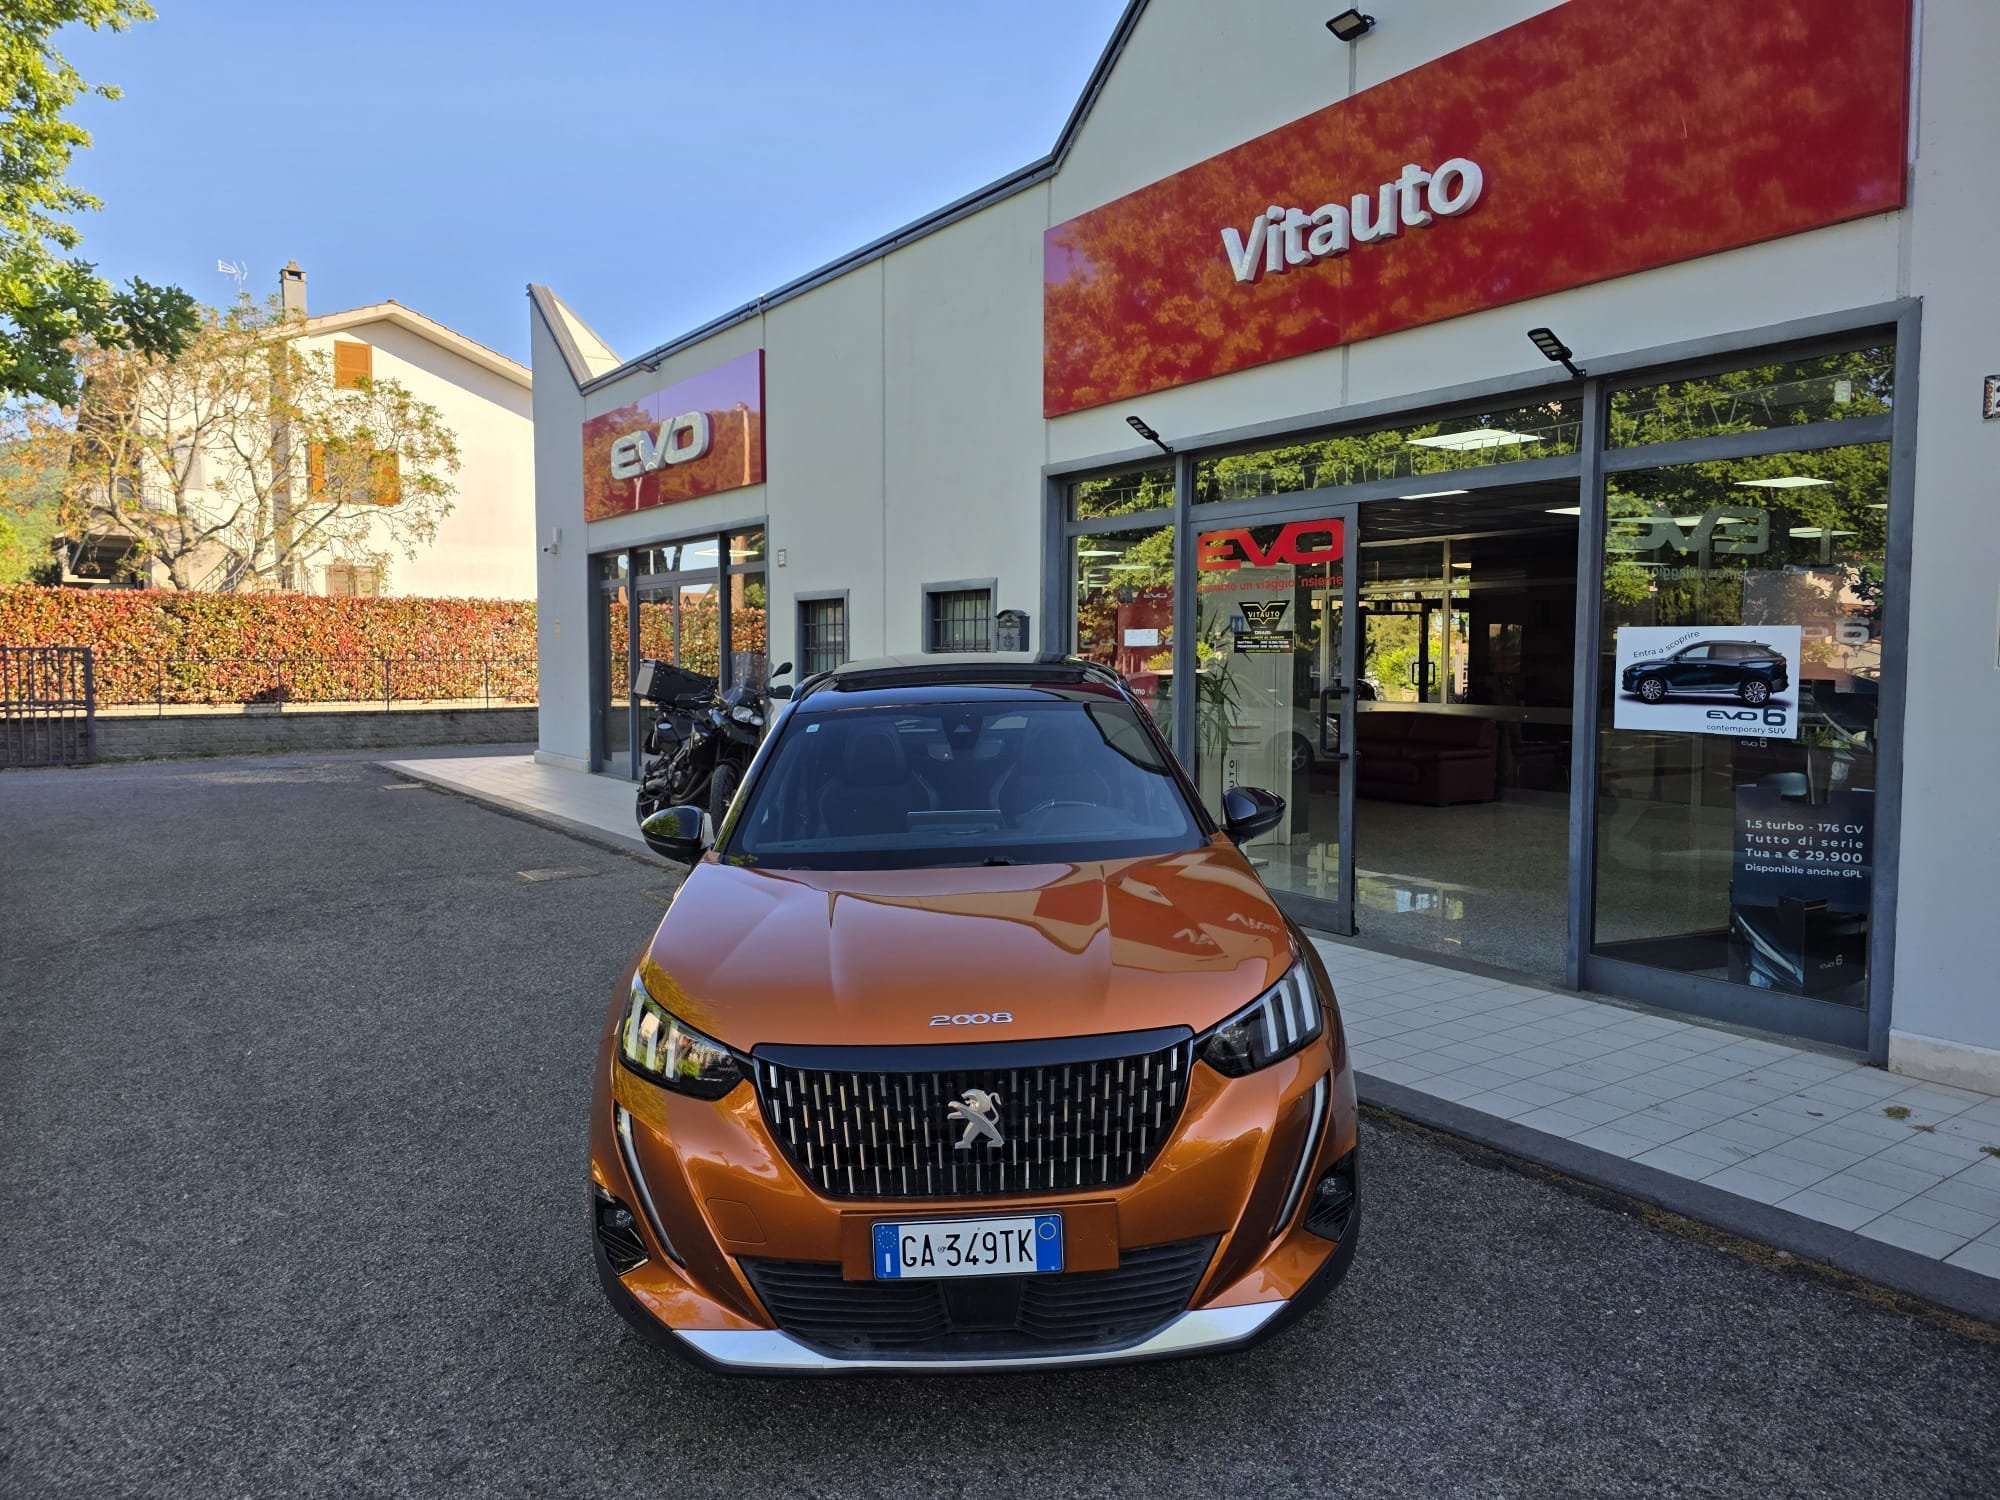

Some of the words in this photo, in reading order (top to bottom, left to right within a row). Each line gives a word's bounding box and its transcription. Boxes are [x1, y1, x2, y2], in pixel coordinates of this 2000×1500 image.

[1220, 157, 1484, 283] Vitauto
[610, 411, 710, 480] EVO
[1197, 518, 1344, 571] EVO
[1633, 648, 1657, 658] Entra
[1665, 631, 1701, 652] scoprire
[1706, 710, 1758, 721] EVO
[1763, 705, 1787, 727] 6
[1706, 724, 1766, 735] contemporary
[1768, 727, 1787, 735] SUV
[1745, 819, 1762, 829] 1.5
[1766, 820, 1804, 831] turbo
[1818, 823, 1840, 833] 176
[1844, 825, 1863, 834] CV
[1745, 833, 1790, 845] Tutto
[1798, 836, 1813, 846] di
[1821, 839, 1863, 849] serie
[1745, 848, 1769, 858] Tua
[1788, 849, 1800, 860] €
[1805, 850, 1863, 864] 29.900
[1745, 863, 1805, 874] Disponibile
[1806, 867, 1840, 877] anche
[1842, 869, 1863, 878] GPL
[929, 1012, 1014, 1026] 2008
